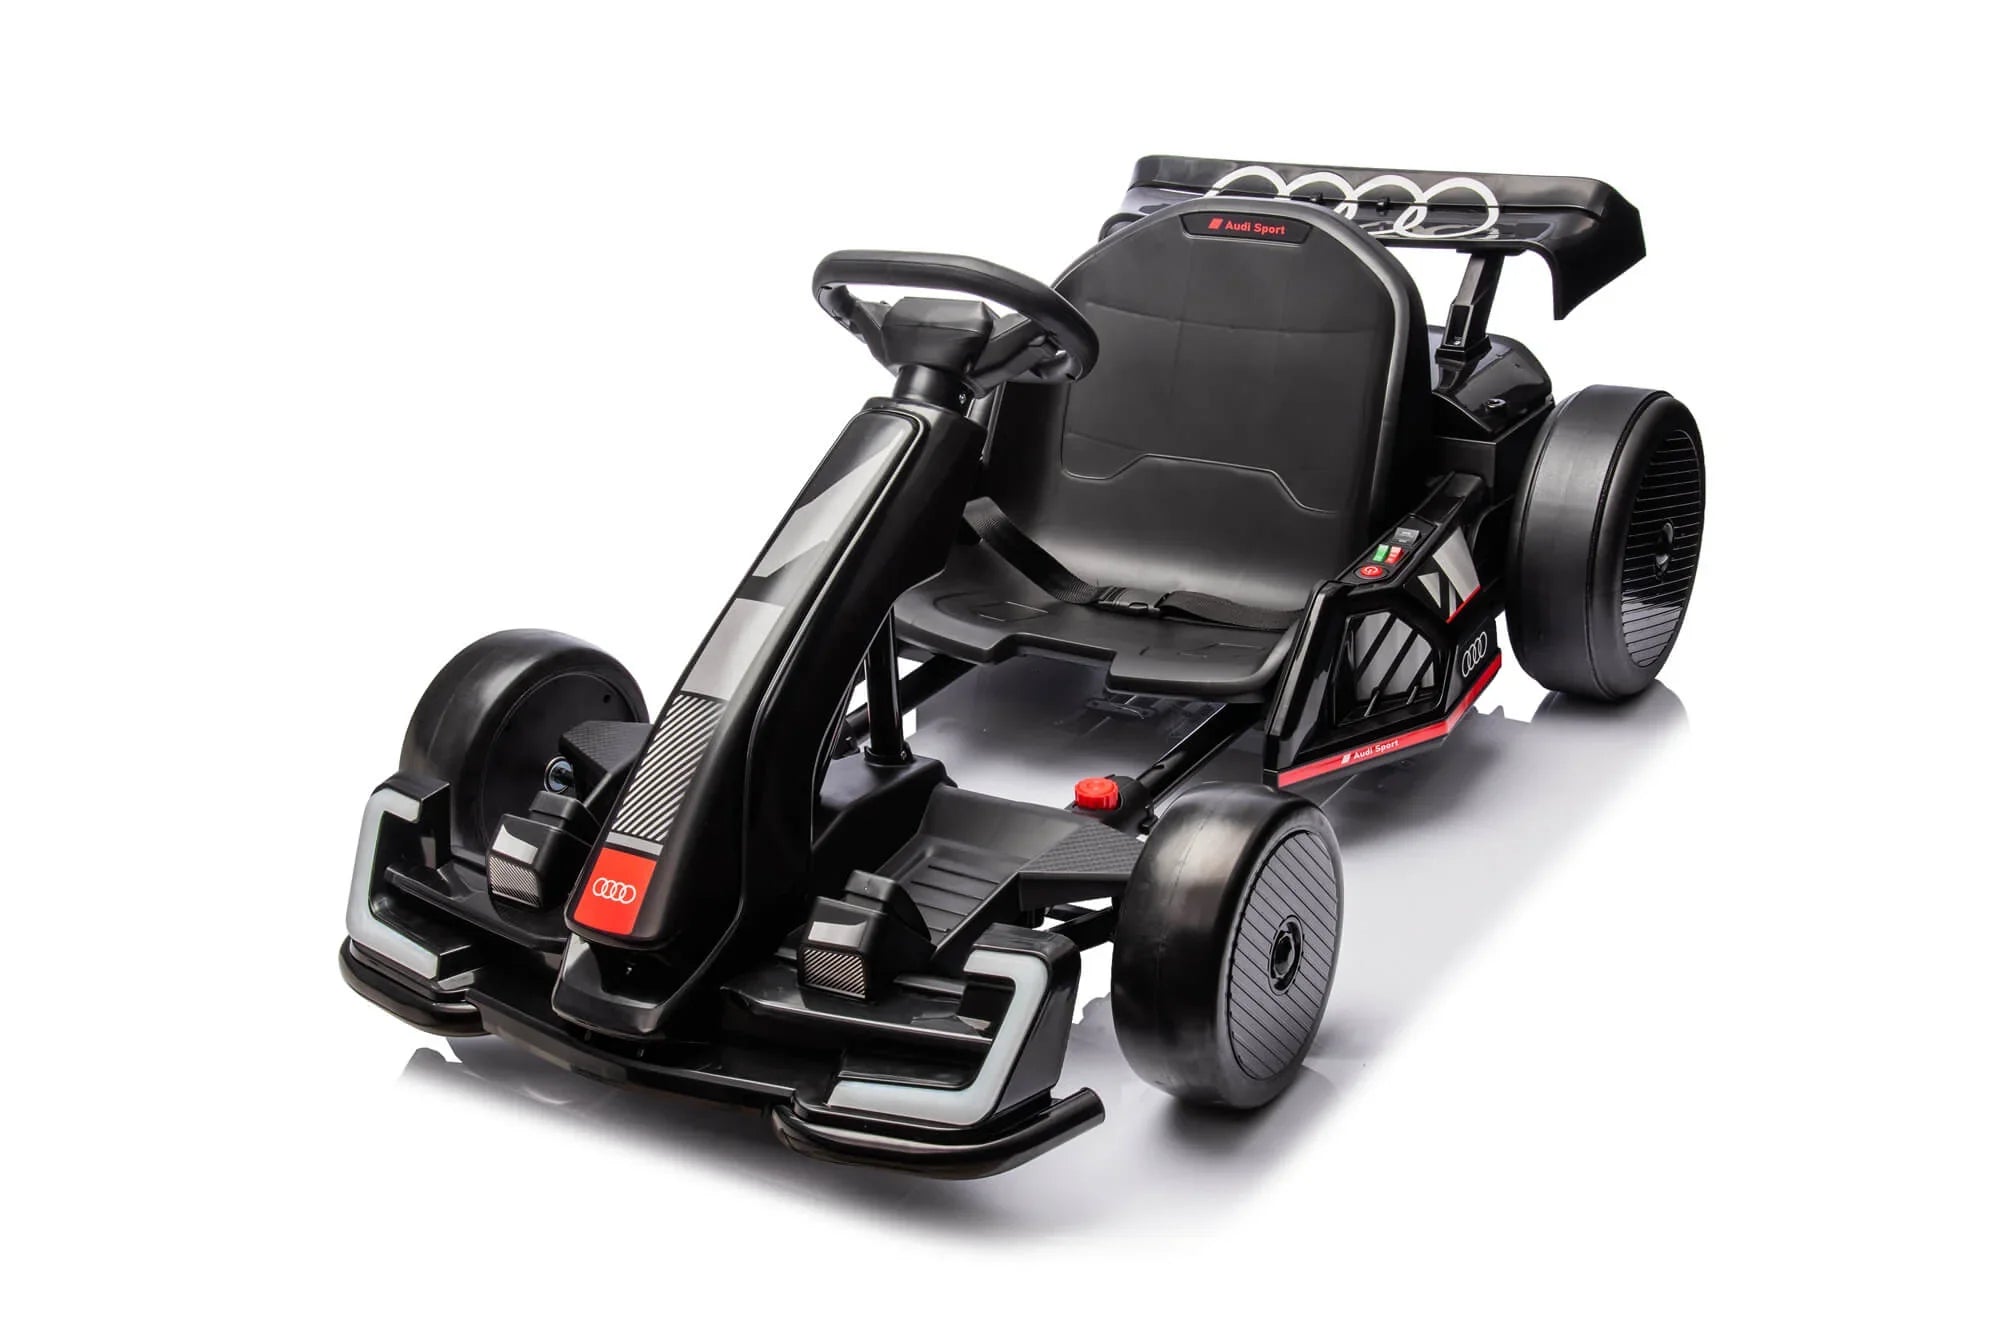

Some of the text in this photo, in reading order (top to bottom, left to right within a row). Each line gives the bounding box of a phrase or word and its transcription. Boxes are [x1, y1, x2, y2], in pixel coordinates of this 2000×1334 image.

[1225, 220, 1285, 235] Audi Sport
[1353, 740, 1399, 759] Audi Sport
